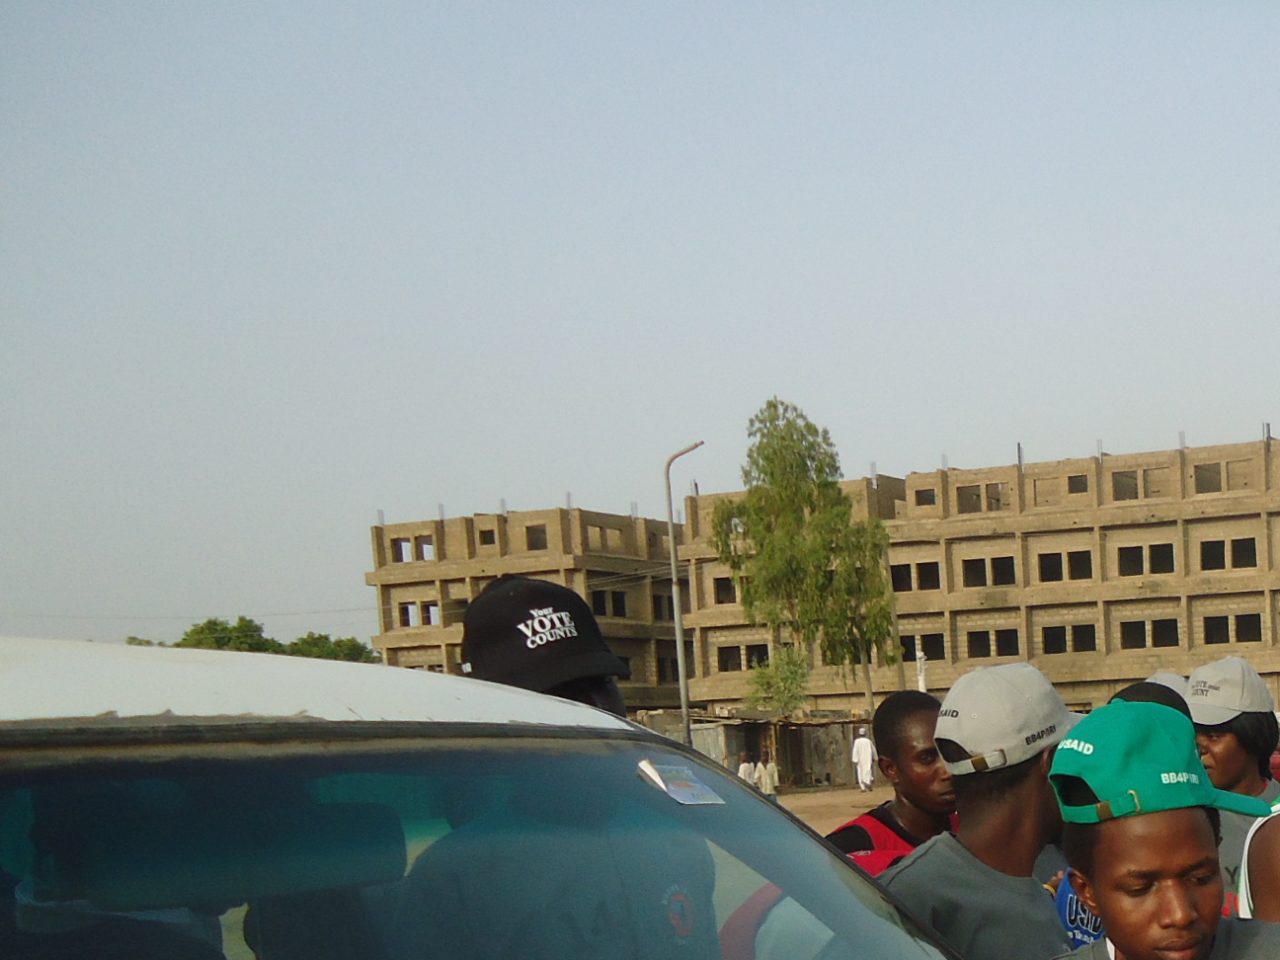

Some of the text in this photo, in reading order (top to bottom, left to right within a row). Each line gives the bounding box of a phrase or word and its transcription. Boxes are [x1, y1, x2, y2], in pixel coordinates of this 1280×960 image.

[529, 606, 554, 618] Your
[516, 611, 575, 638] VOTE
[526, 626, 578, 649] COUNTS
[938, 708, 960, 719] SAID
[1058, 738, 1094, 756] USAID
